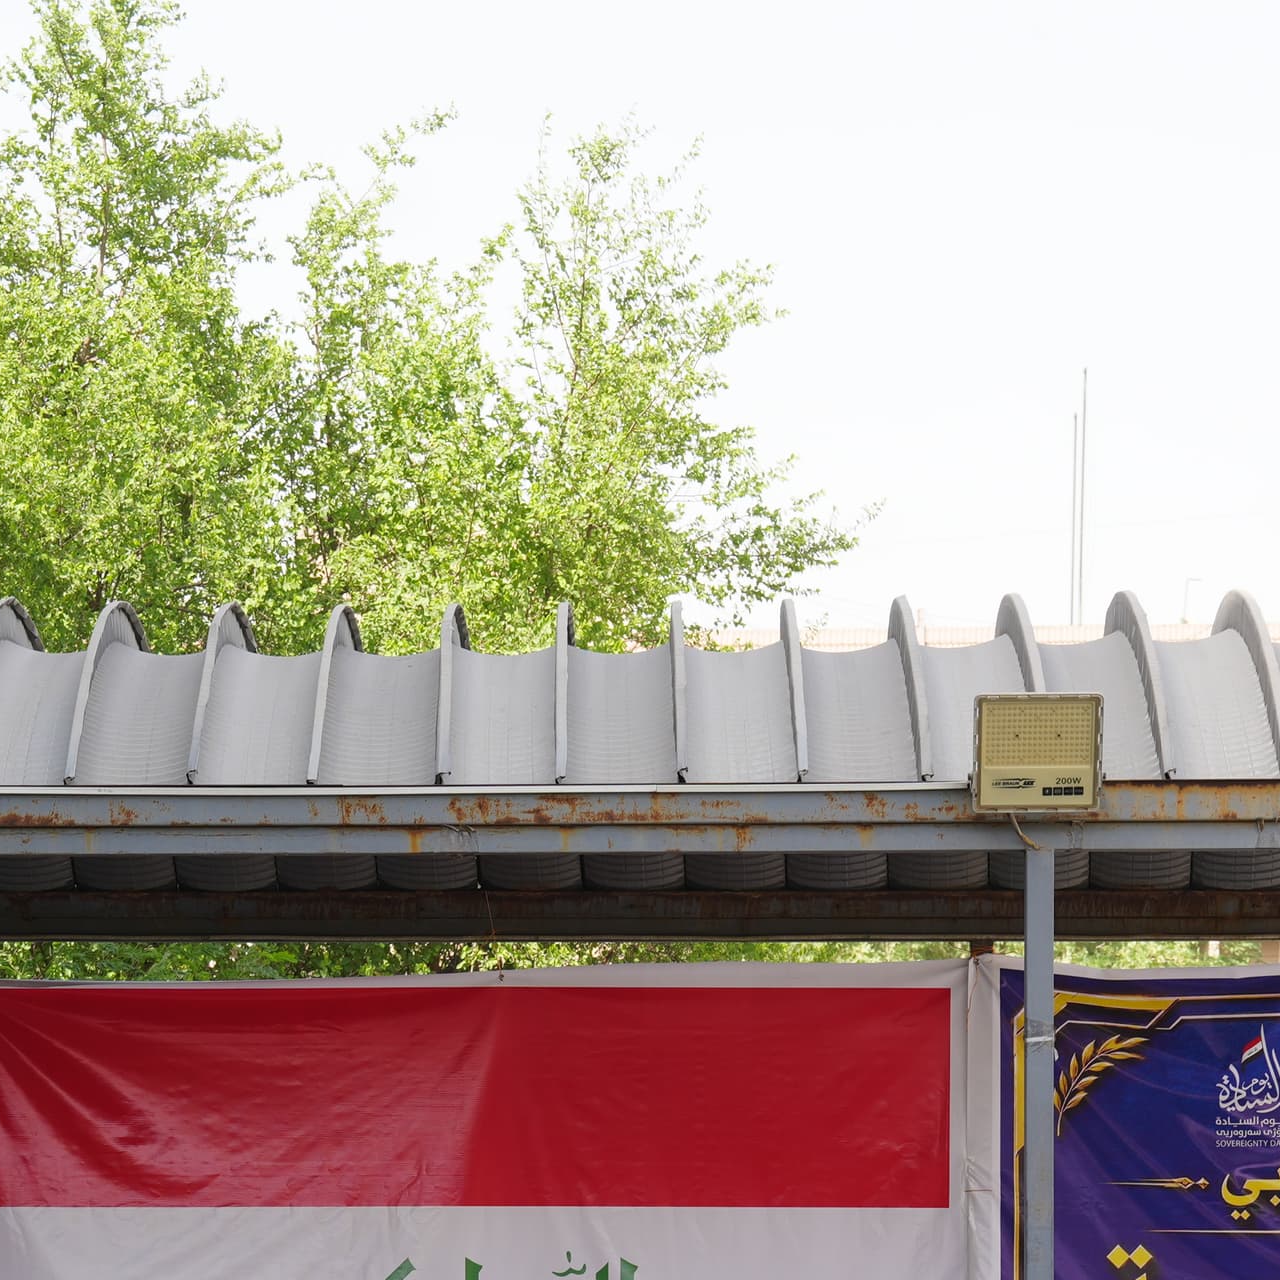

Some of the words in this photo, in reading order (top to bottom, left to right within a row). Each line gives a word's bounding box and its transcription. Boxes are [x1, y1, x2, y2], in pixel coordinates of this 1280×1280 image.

[1055, 777, 1081, 785] 200W
[1215, 1116, 1259, 1128] السيادة
[1216, 1139, 1269, 1148] SOVEREIGNTY
